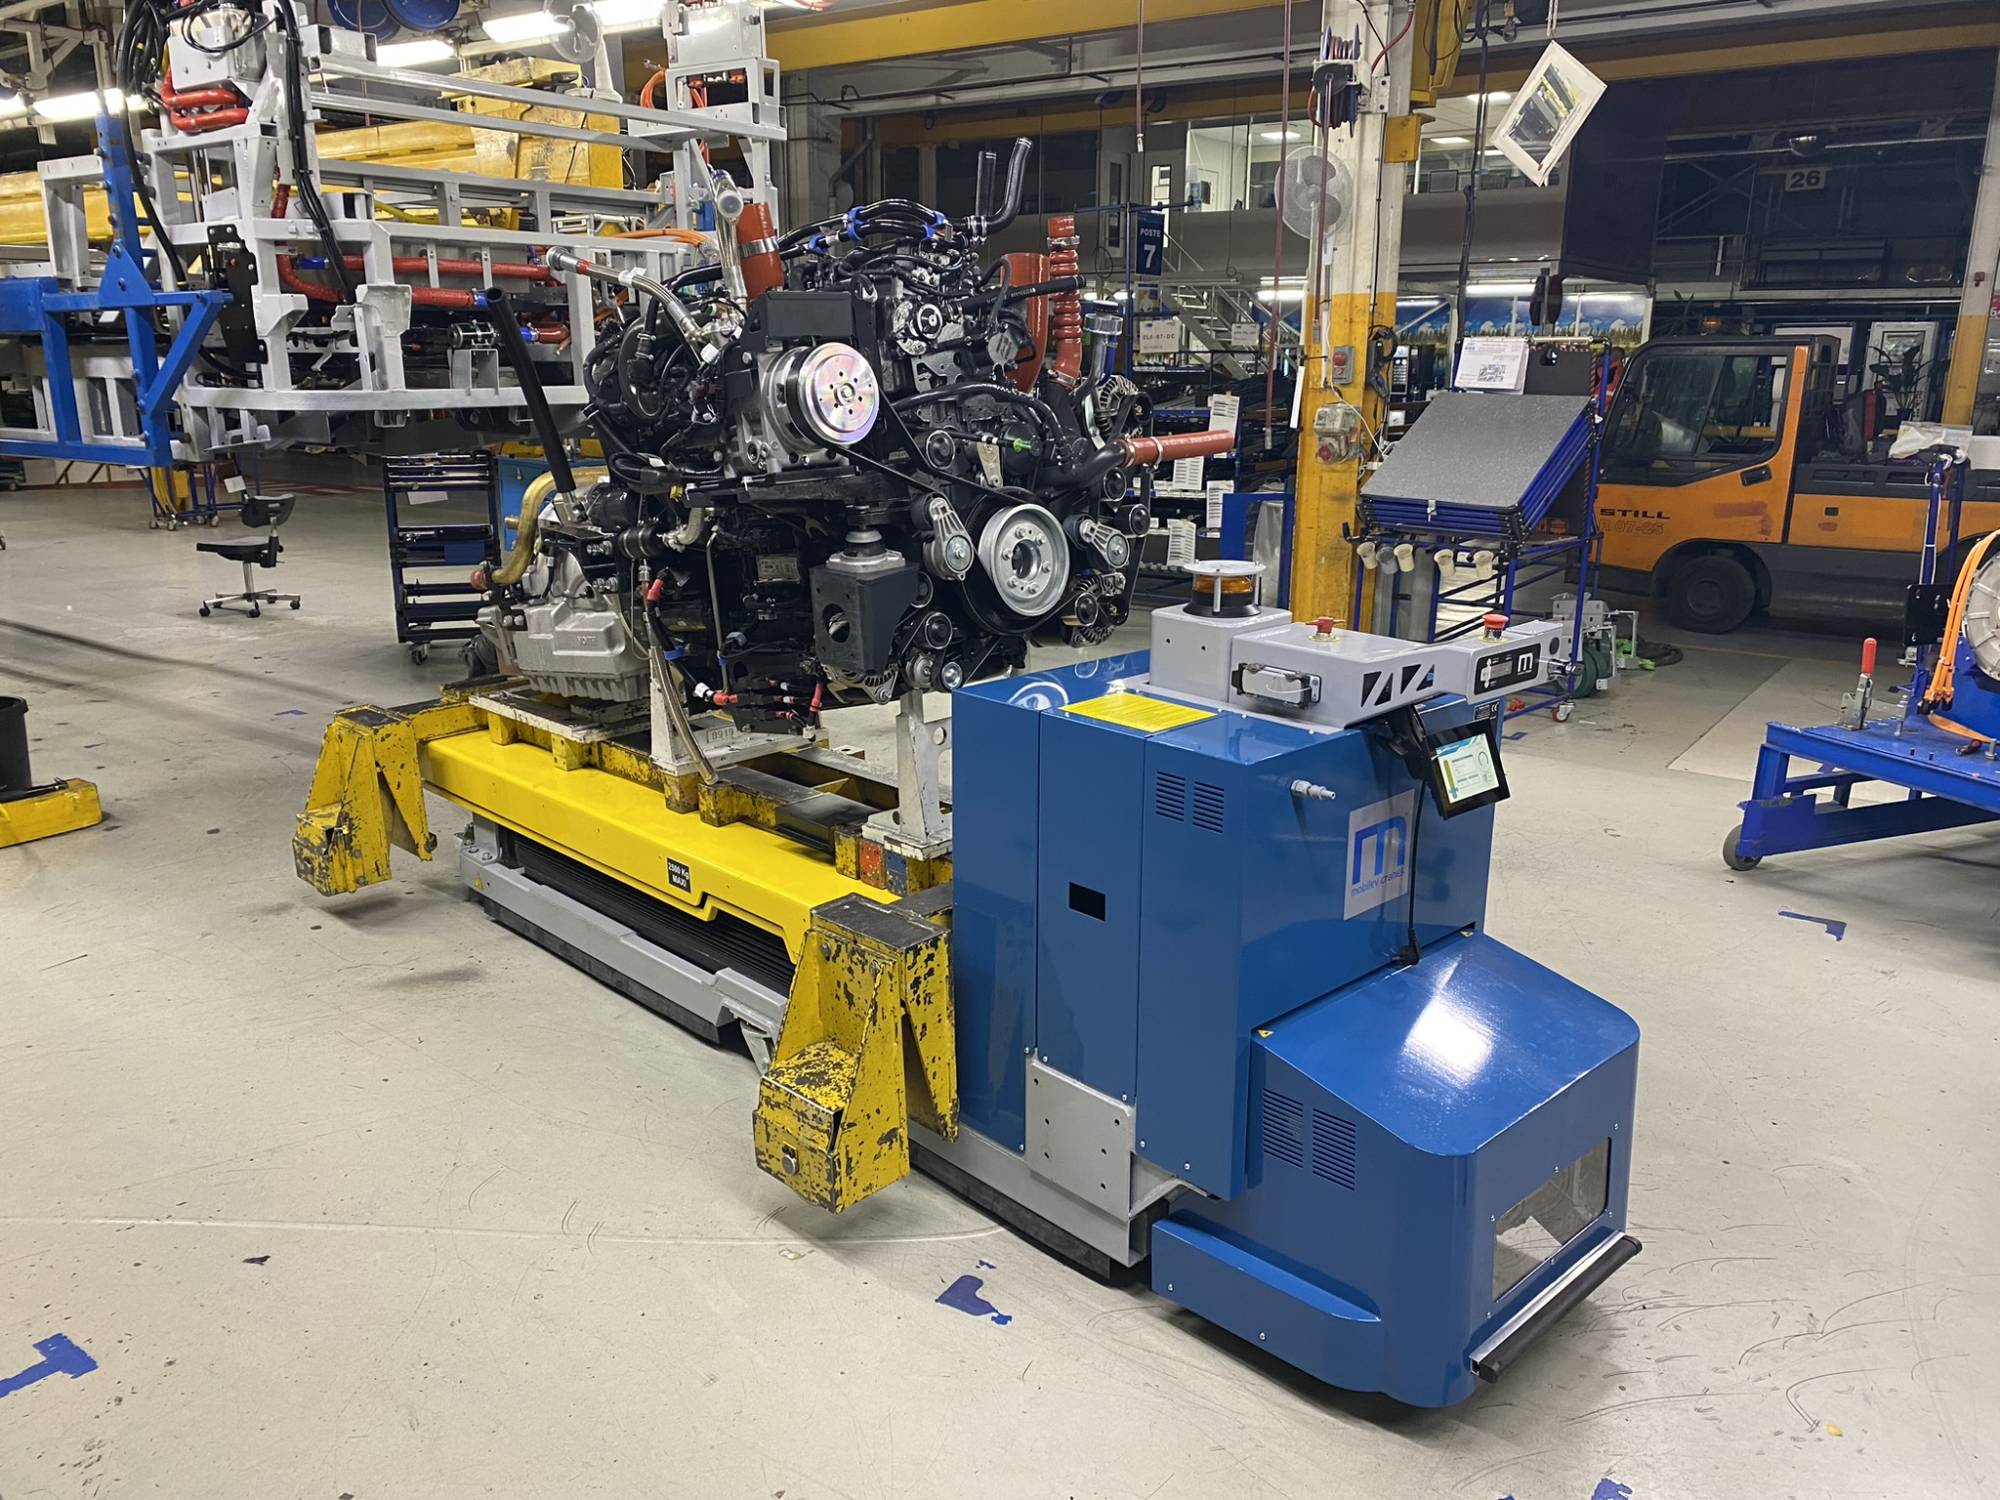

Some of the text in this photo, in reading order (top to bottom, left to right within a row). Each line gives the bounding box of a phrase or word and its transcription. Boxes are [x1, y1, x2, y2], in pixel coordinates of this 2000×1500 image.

[1790, 170, 1821, 189] 26
[1140, 227, 1161, 238] POSTE
[1143, 244, 1157, 269] 7
[1600, 508, 1671, 520] STILL
